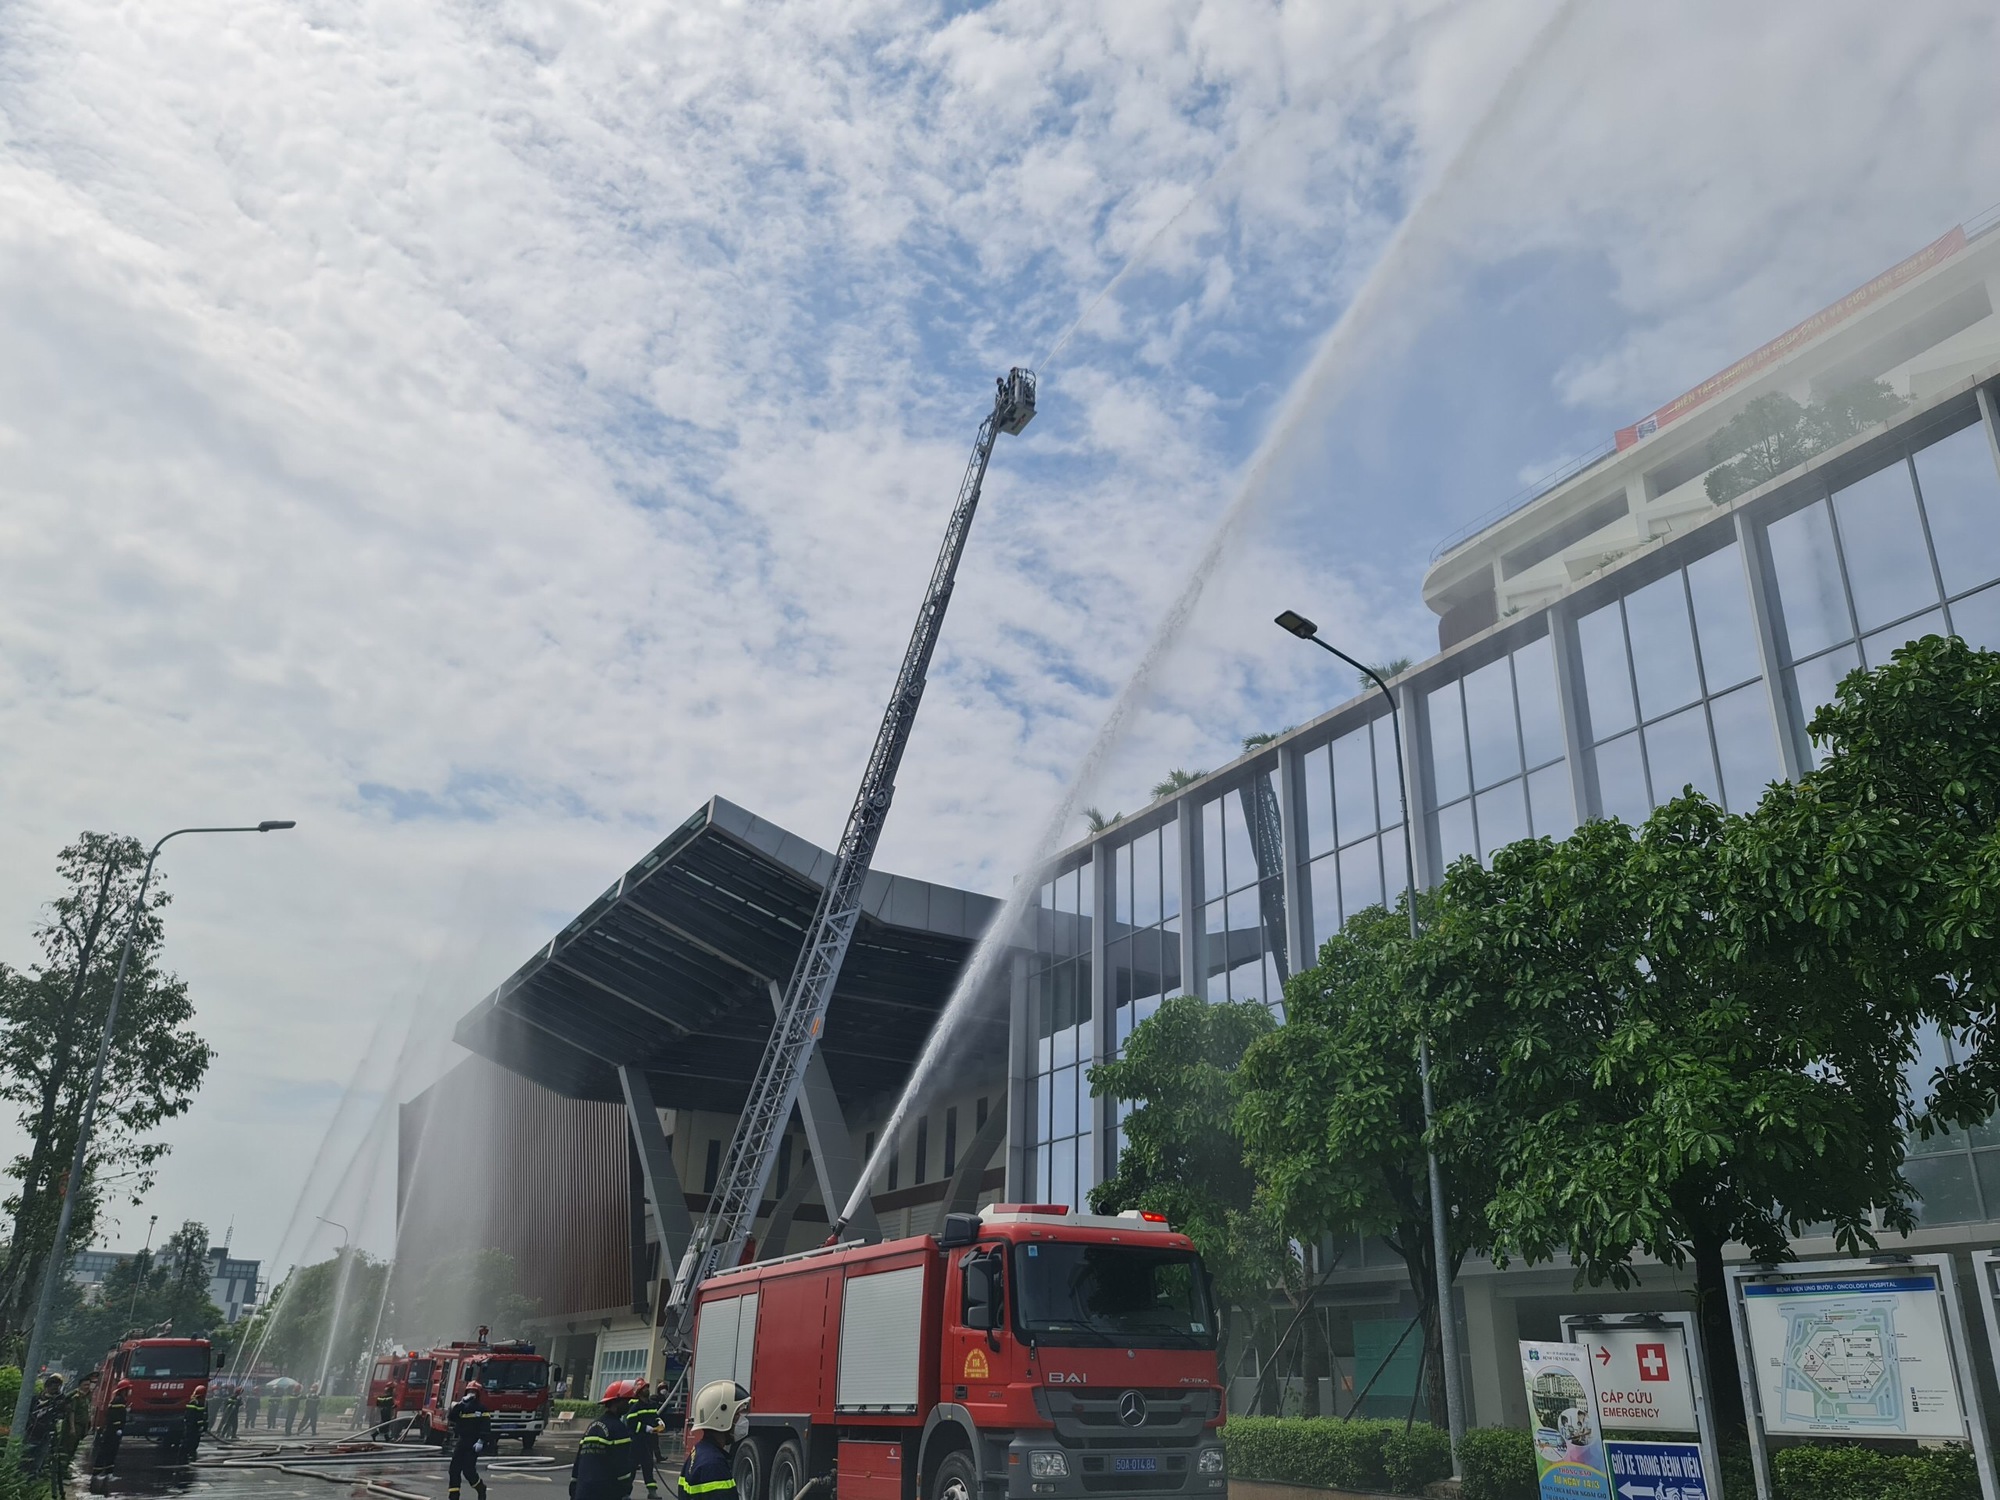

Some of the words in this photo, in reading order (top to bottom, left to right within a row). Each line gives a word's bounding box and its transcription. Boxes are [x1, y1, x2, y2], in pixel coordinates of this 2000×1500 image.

[1837, 1282, 1868, 1290] ONCOLOGY
[1048, 1372, 1087, 1383] BAI
[150, 1382, 185, 1390] sides
[1627, 1389, 1653, 1404] CỨU
[1602, 1407, 1660, 1418] EMERGENCY
[1624, 1454, 1636, 1475] XE
[1634, 1454, 1661, 1476] TRONG
[1660, 1451, 1682, 1482] BỆNH
[1680, 1452, 1701, 1483] VIỆN
